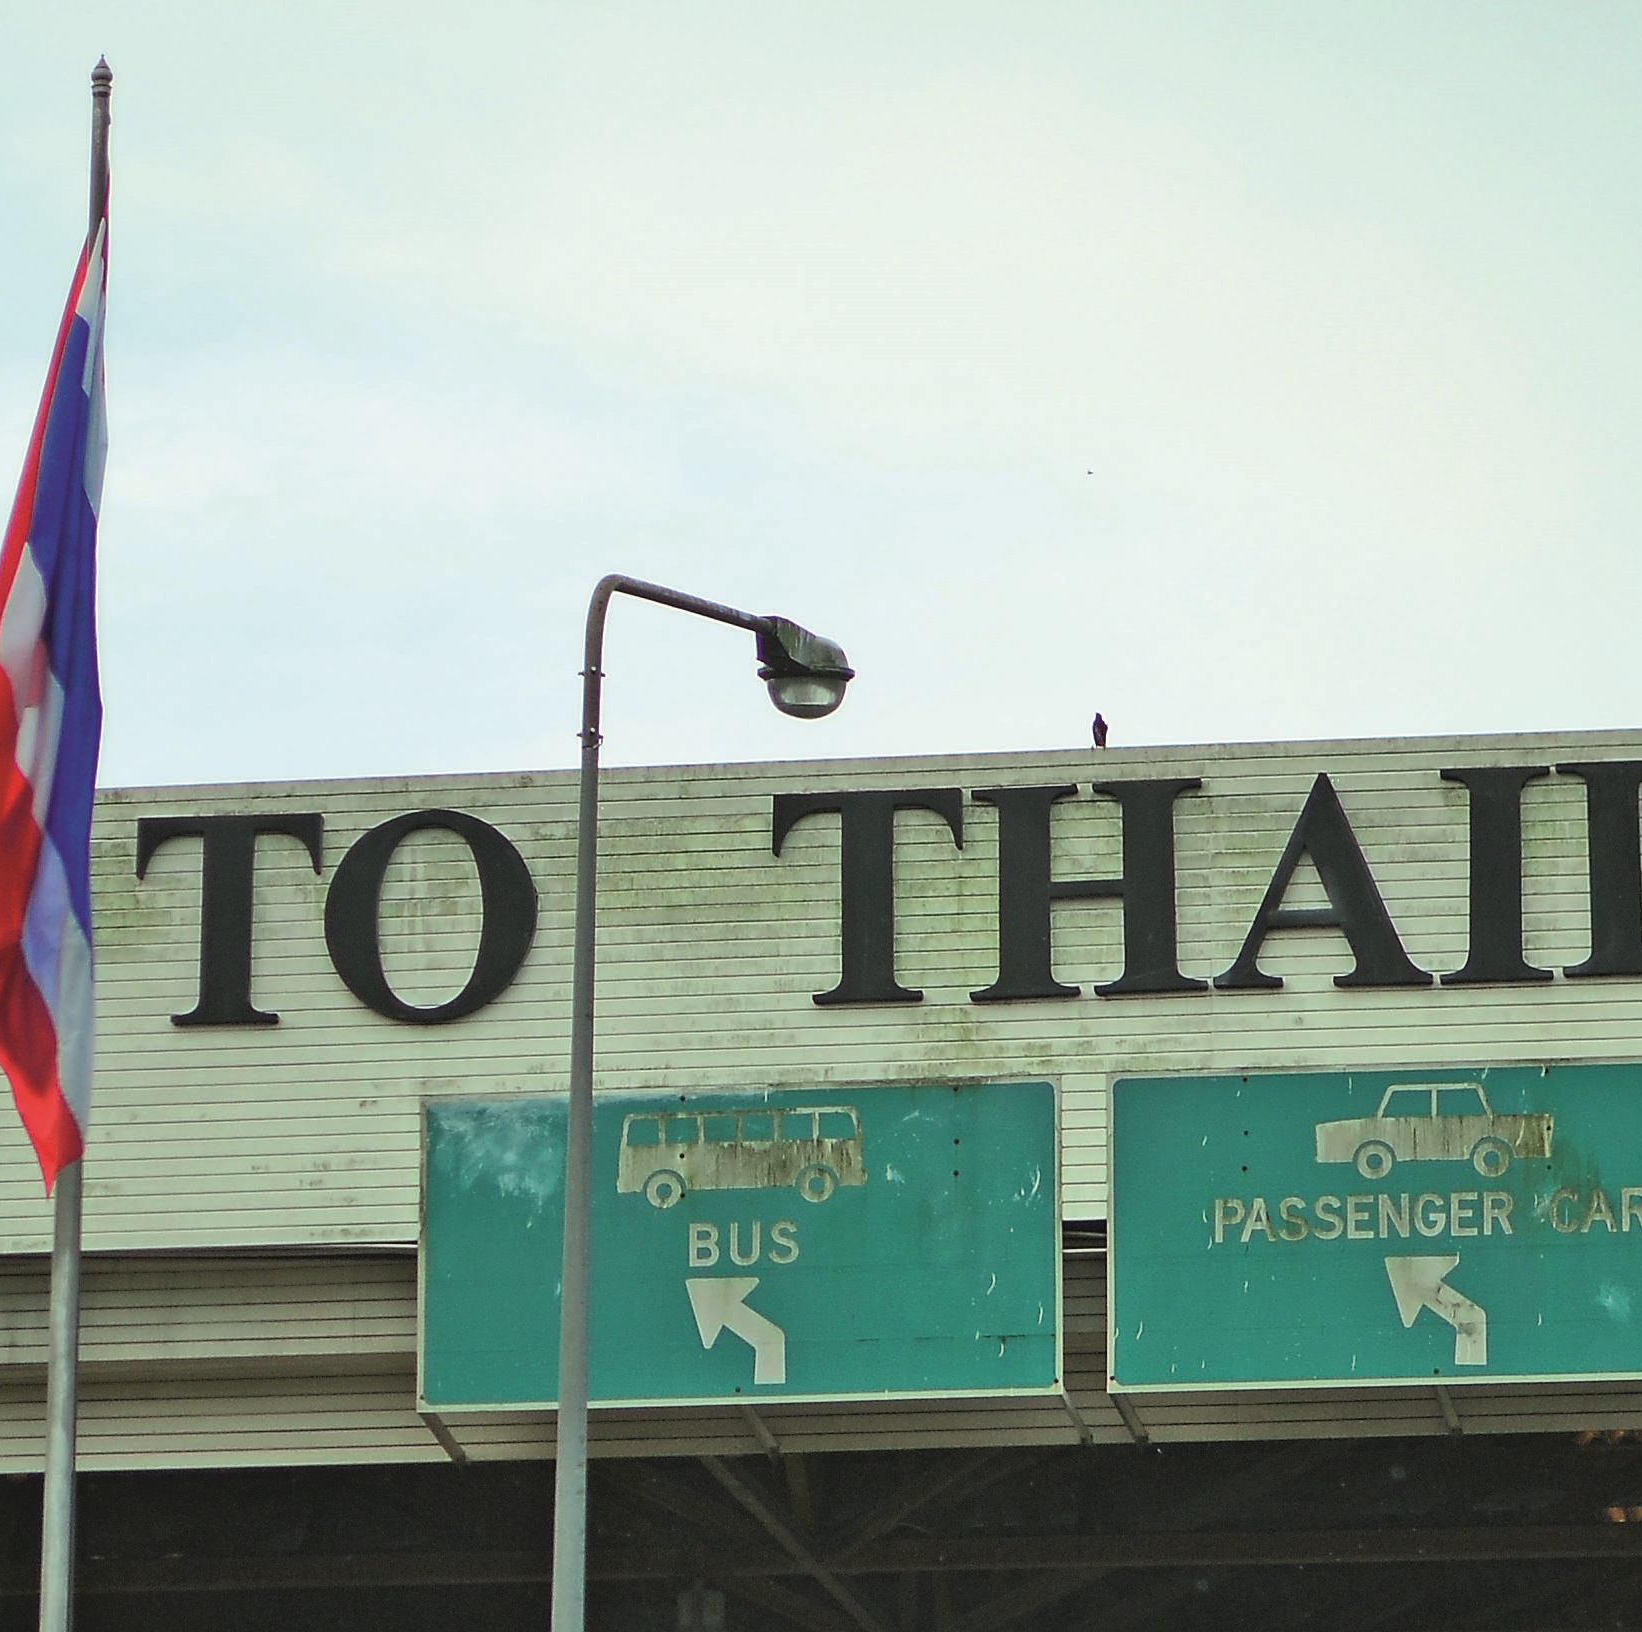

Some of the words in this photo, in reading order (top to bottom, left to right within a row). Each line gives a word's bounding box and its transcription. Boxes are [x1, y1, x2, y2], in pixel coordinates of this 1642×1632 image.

[136, 809, 538, 1026] TO
[1213, 1191, 1513, 1243] PASSENGER
[688, 1221, 800, 1268] BUS
